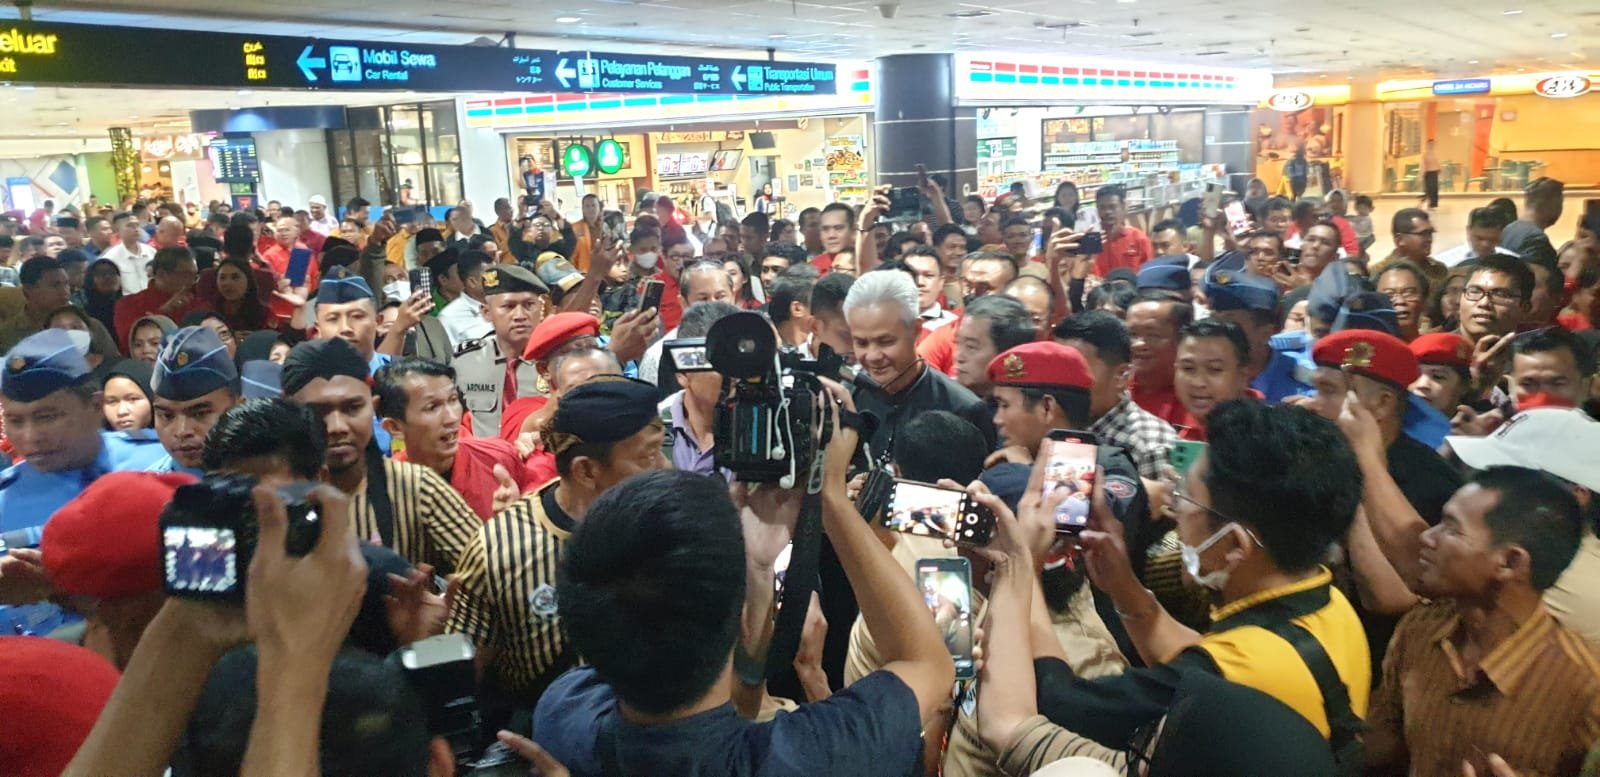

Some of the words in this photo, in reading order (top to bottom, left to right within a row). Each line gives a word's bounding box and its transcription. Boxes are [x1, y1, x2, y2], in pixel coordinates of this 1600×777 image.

[363, 49, 398, 65] Mobil
[400, 50, 436, 67] Sewa
[365, 69, 381, 80] Car
[382, 70, 409, 80] Rental
[600, 59, 647, 78] Pelayanan
[647, 61, 692, 80] Pelanggan
[763, 66, 810, 83] Transportasi
[810, 67, 834, 81] Umum
[602, 78, 634, 88] Customer
[635, 79, 663, 89] Services
[764, 82, 781, 91] Public
